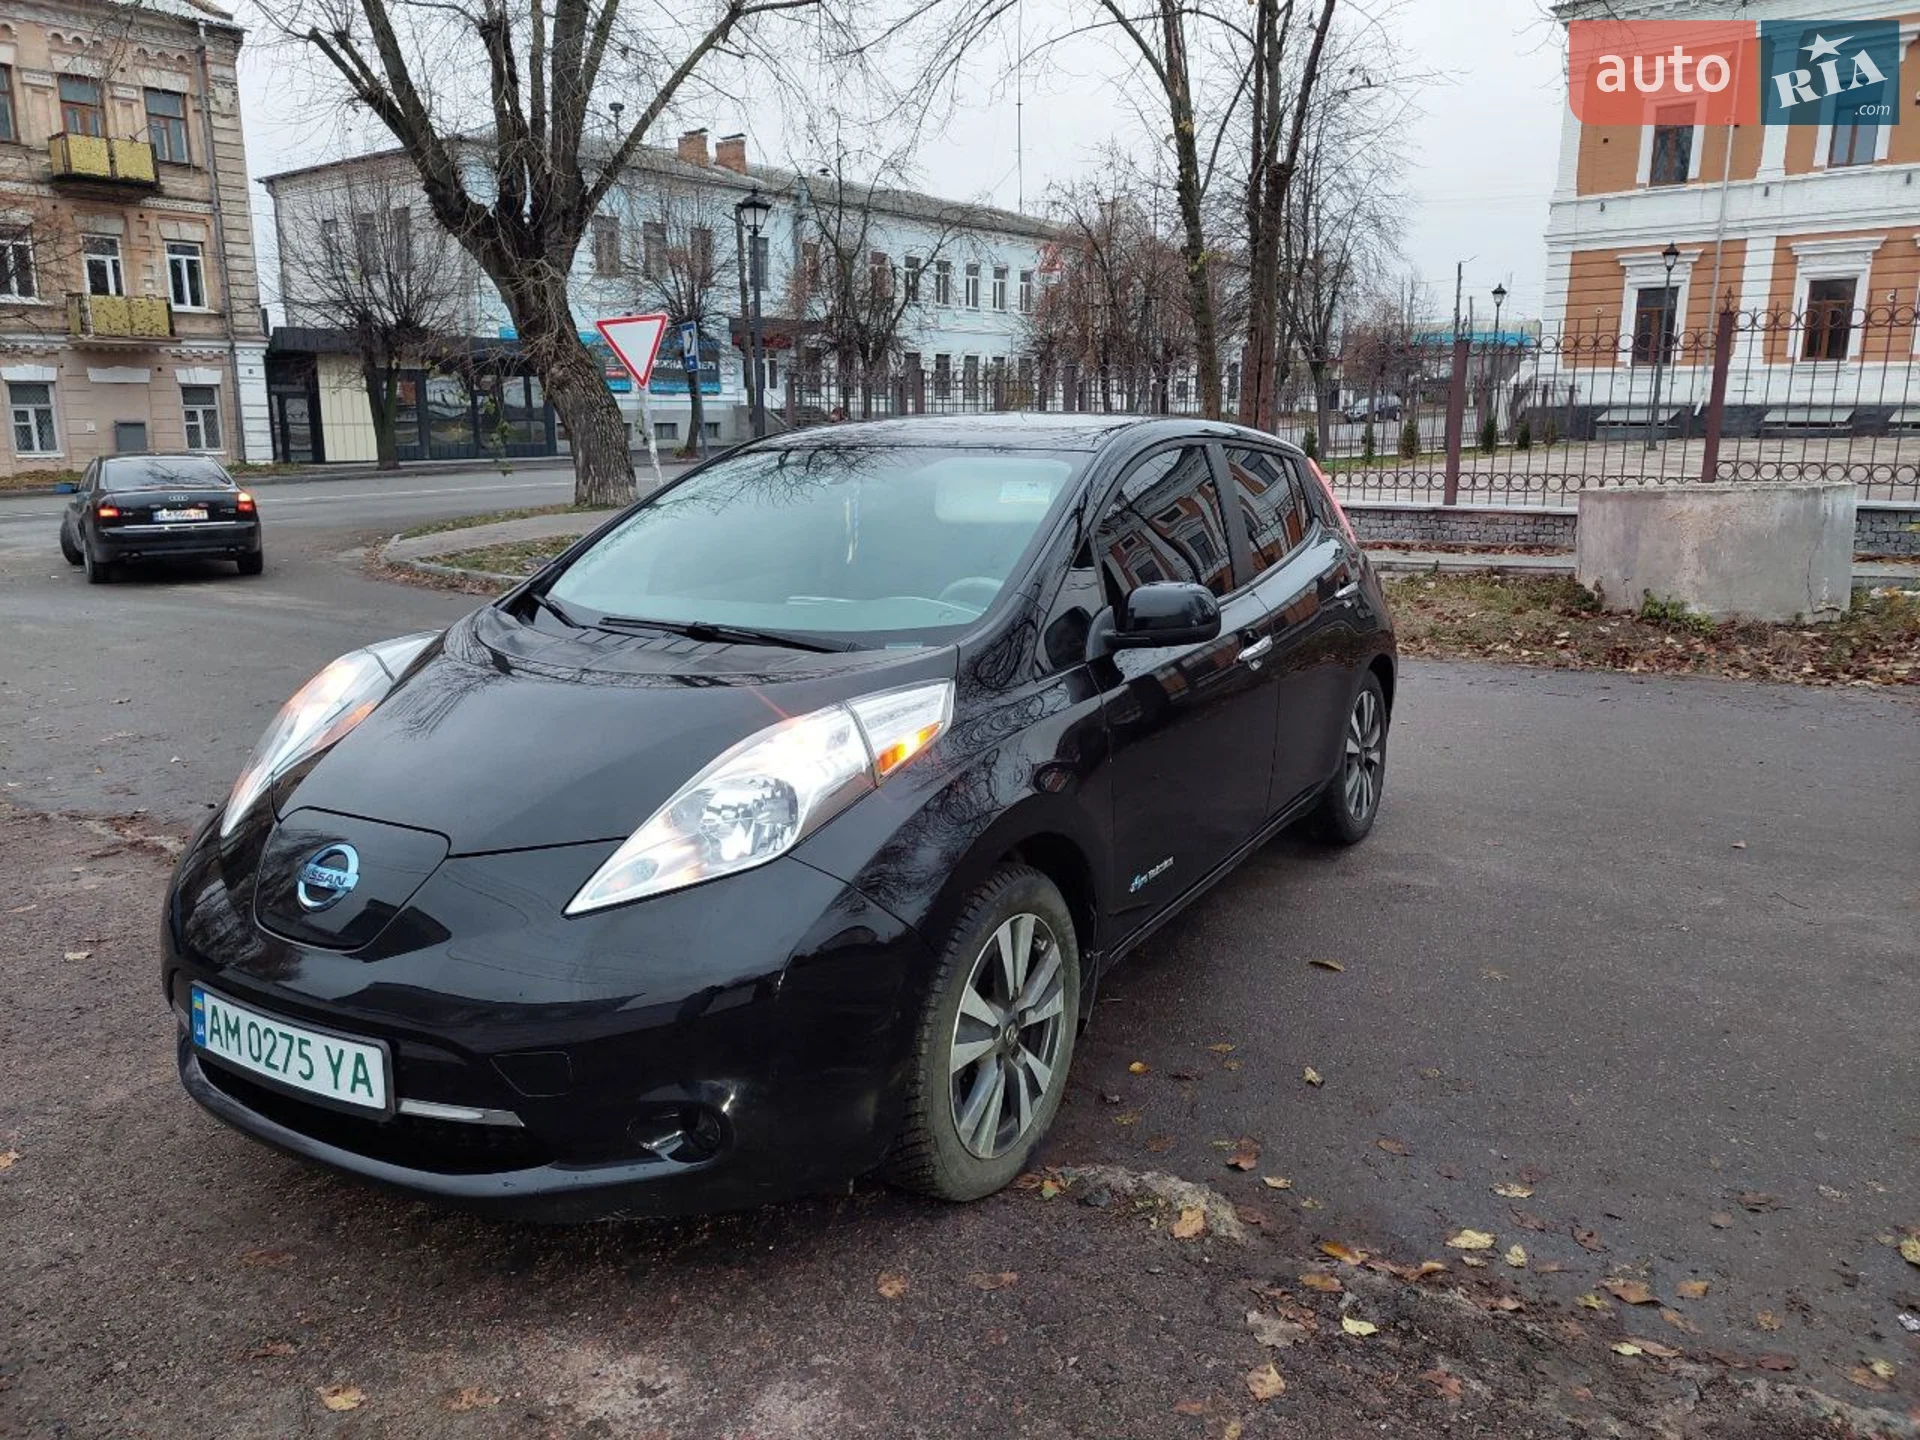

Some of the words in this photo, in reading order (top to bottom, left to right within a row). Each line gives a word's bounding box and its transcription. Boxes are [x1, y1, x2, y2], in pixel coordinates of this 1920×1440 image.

[209, 1004, 242, 1056] AM
[247, 1021, 314, 1081] 0275
[324, 1044, 374, 1098] YA
